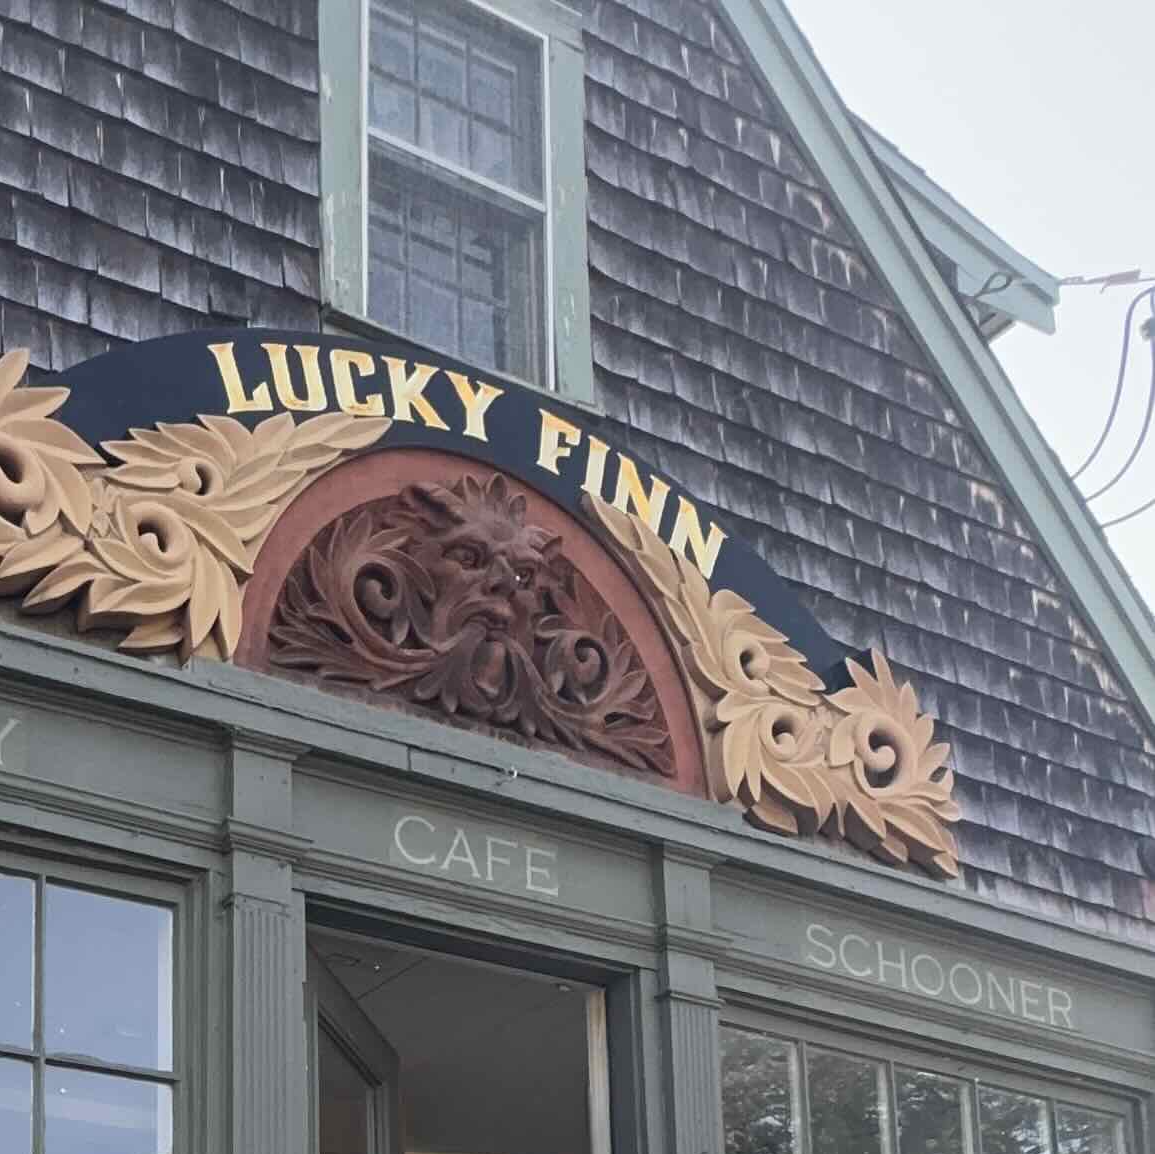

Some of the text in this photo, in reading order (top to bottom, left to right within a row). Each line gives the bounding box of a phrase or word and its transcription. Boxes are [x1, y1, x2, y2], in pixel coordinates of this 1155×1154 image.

[207, 341, 728, 580] LUCKY FINN
[394, 815, 559, 897] CAFE
[806, 923, 1073, 1029] SCHOONER
